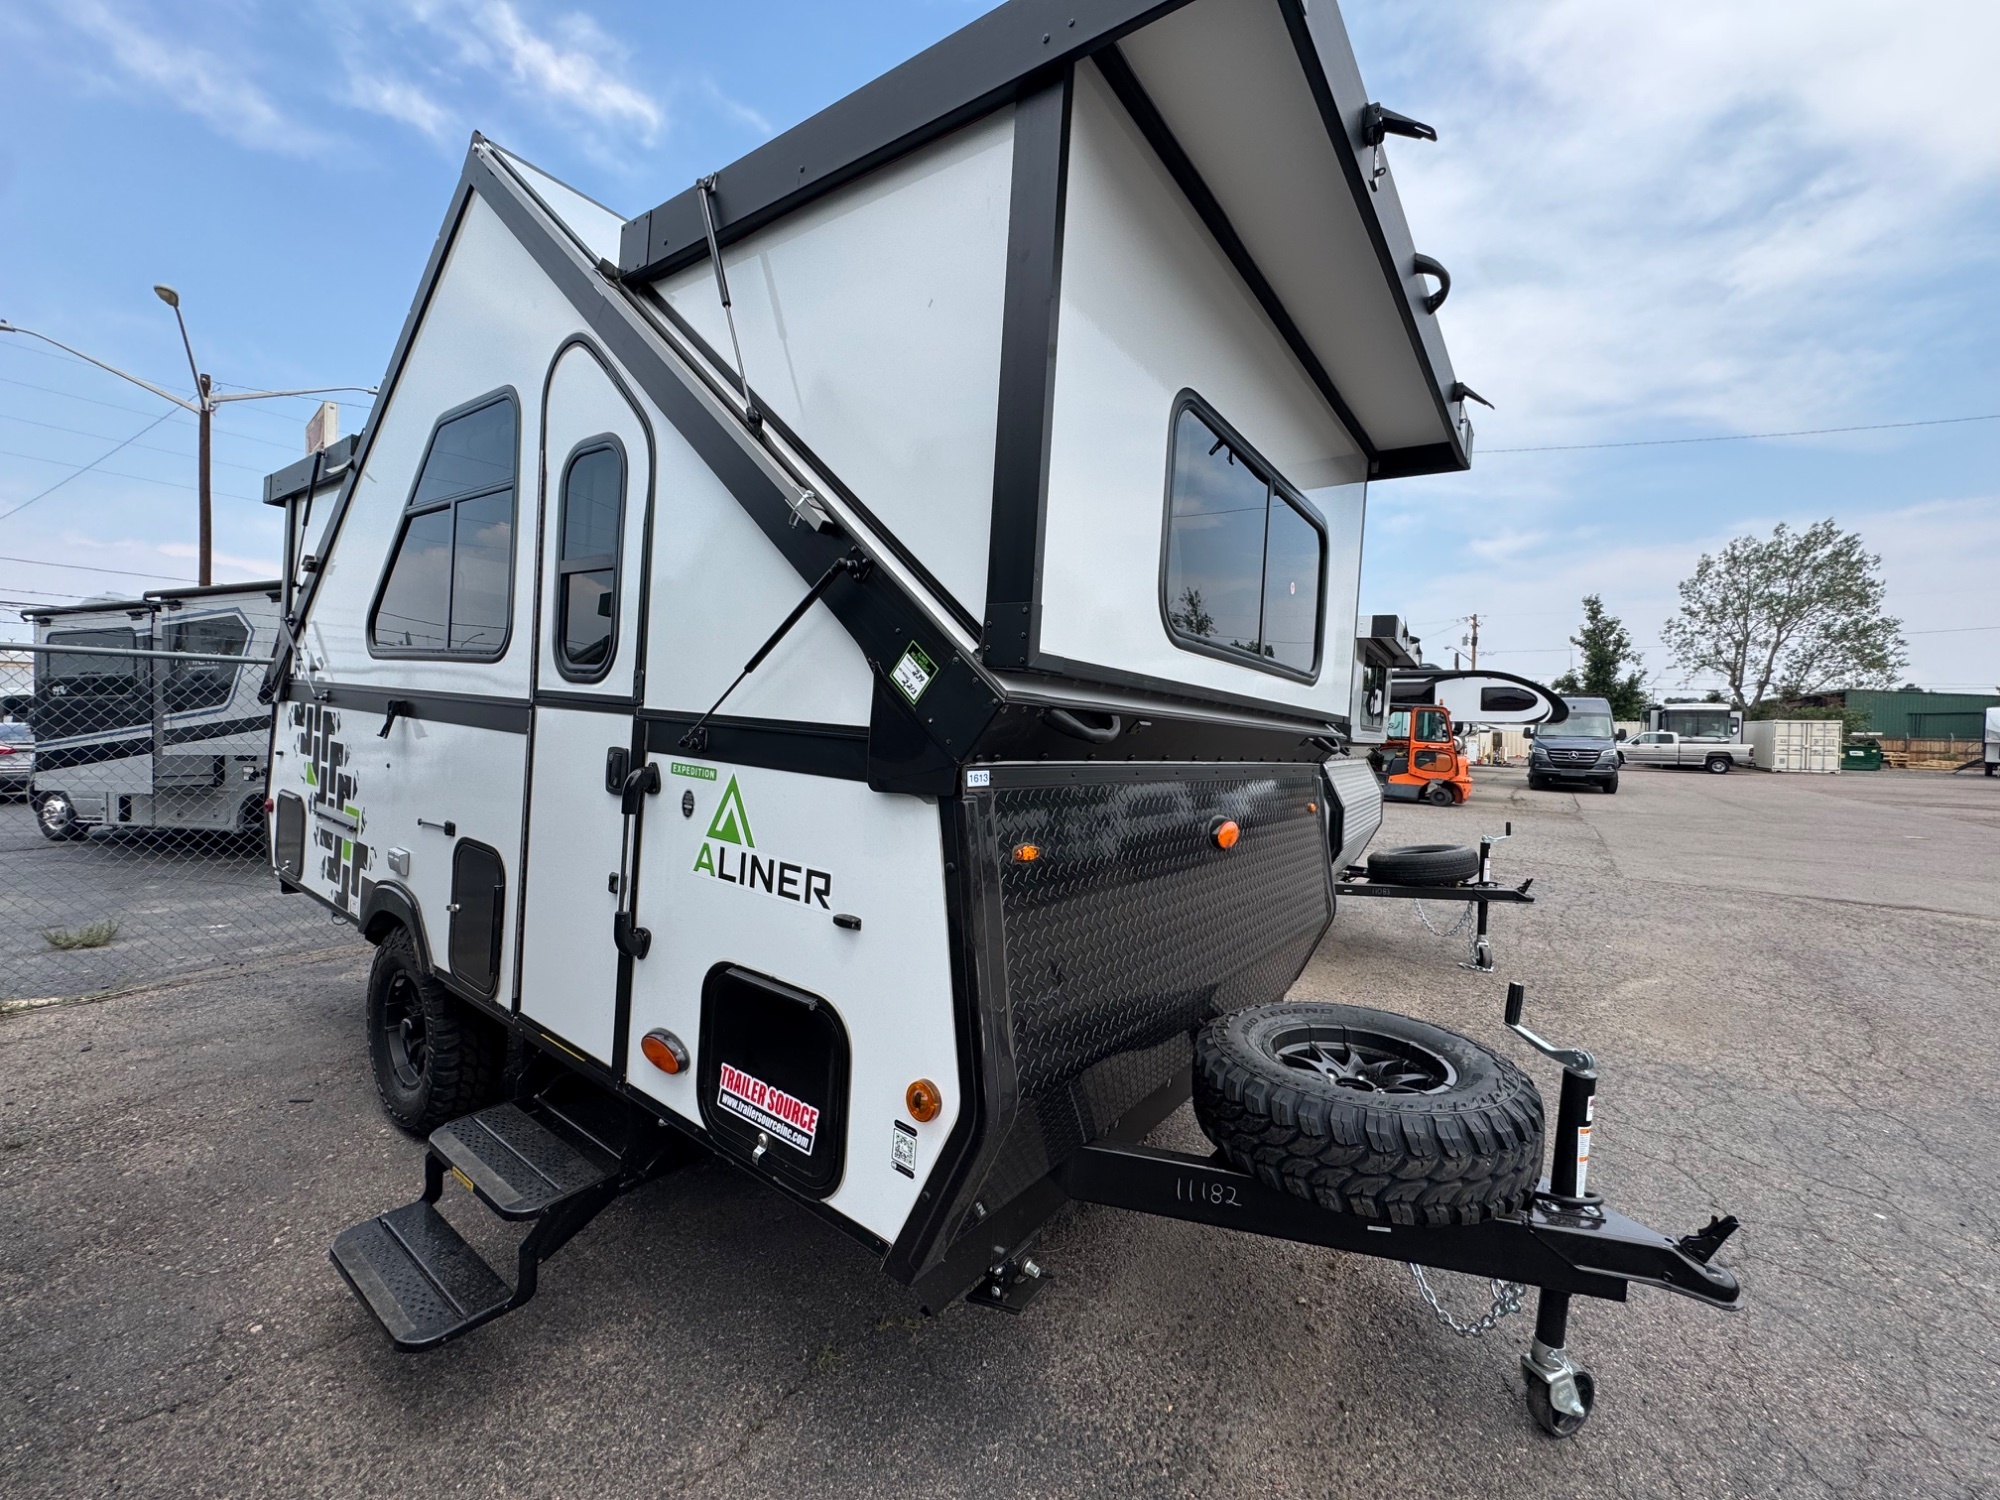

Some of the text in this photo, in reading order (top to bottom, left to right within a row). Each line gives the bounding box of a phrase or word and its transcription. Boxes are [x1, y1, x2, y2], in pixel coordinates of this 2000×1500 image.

[672, 764, 715, 779] EXPEDITION
[969, 773, 989, 783] 1613
[693, 842, 831, 911] ALINER
[1260, 1007, 1334, 1019] LEGEND
[721, 1065, 818, 1133] TRAILER SOURCE
[721, 1093, 810, 1149] www.trailersourceinc.com
[1176, 1177, 1242, 1207] 11182
